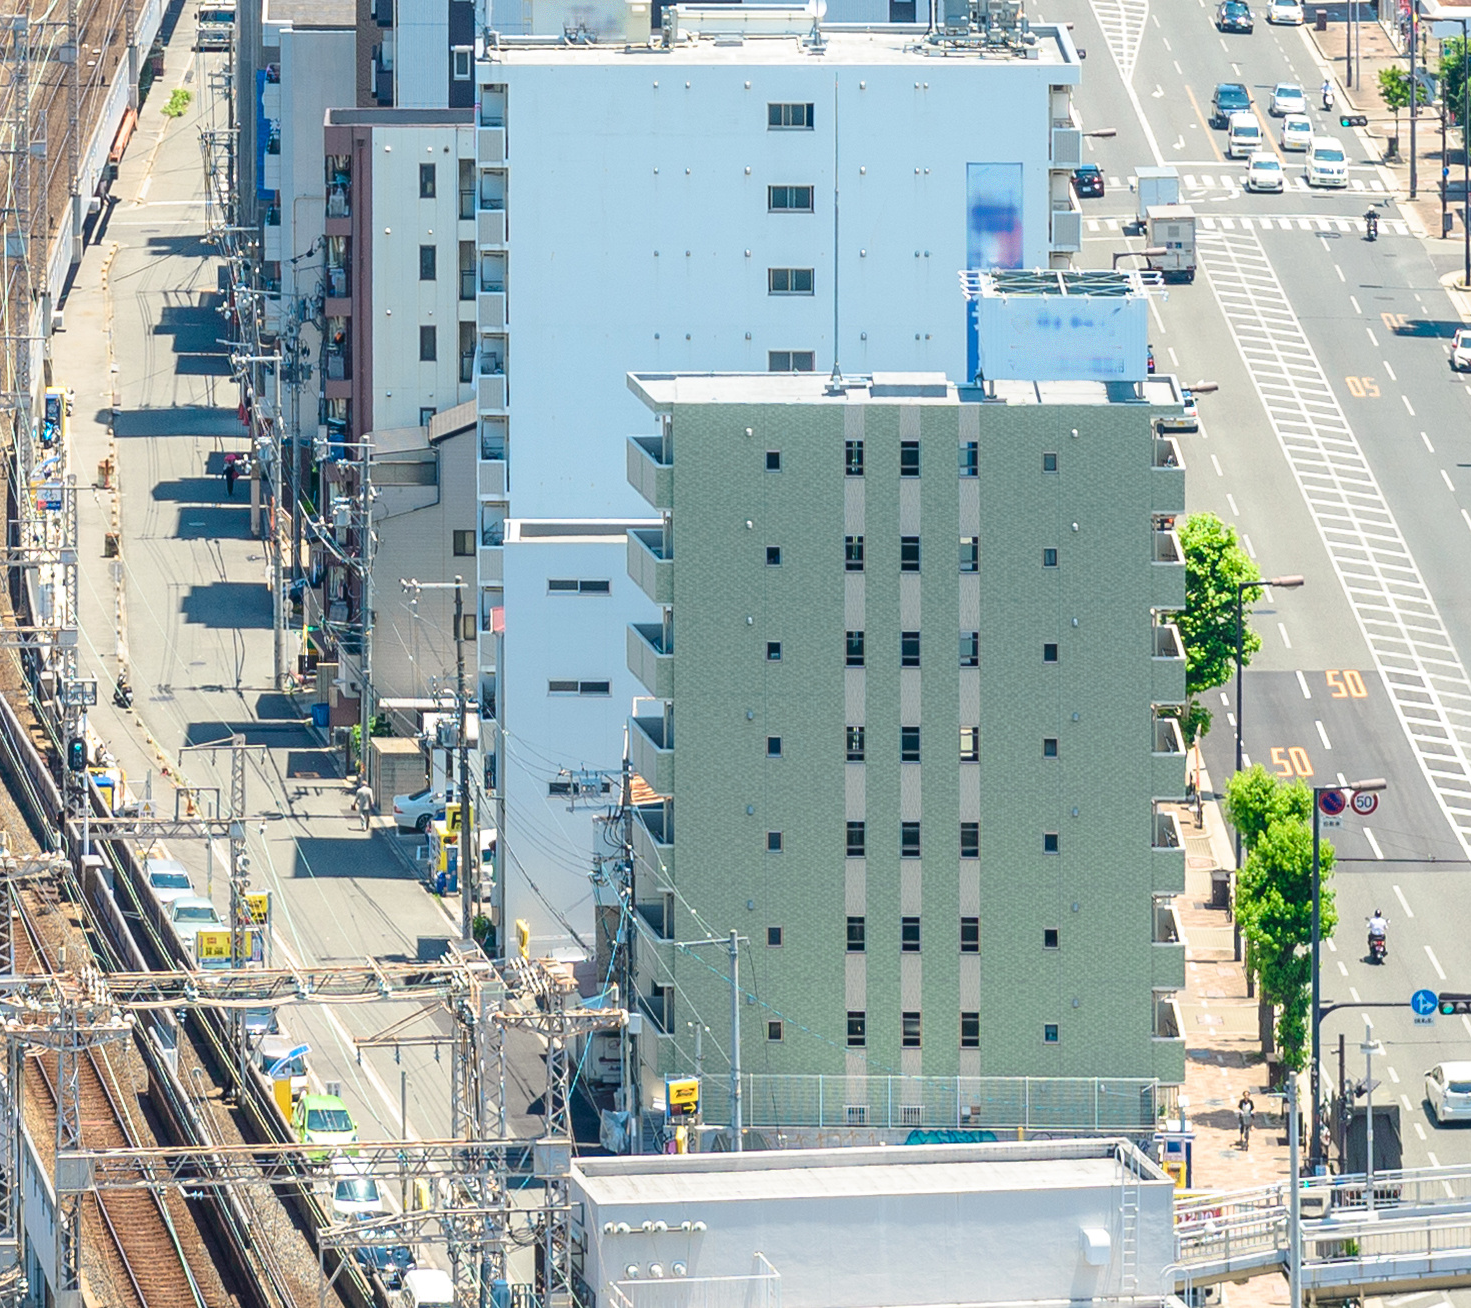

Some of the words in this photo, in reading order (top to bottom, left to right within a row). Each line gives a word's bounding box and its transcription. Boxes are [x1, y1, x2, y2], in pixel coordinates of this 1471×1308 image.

[1325, 669, 1368, 699] 50
[1270, 746, 1315, 778] 50
[1356, 795, 1373, 809] 50
